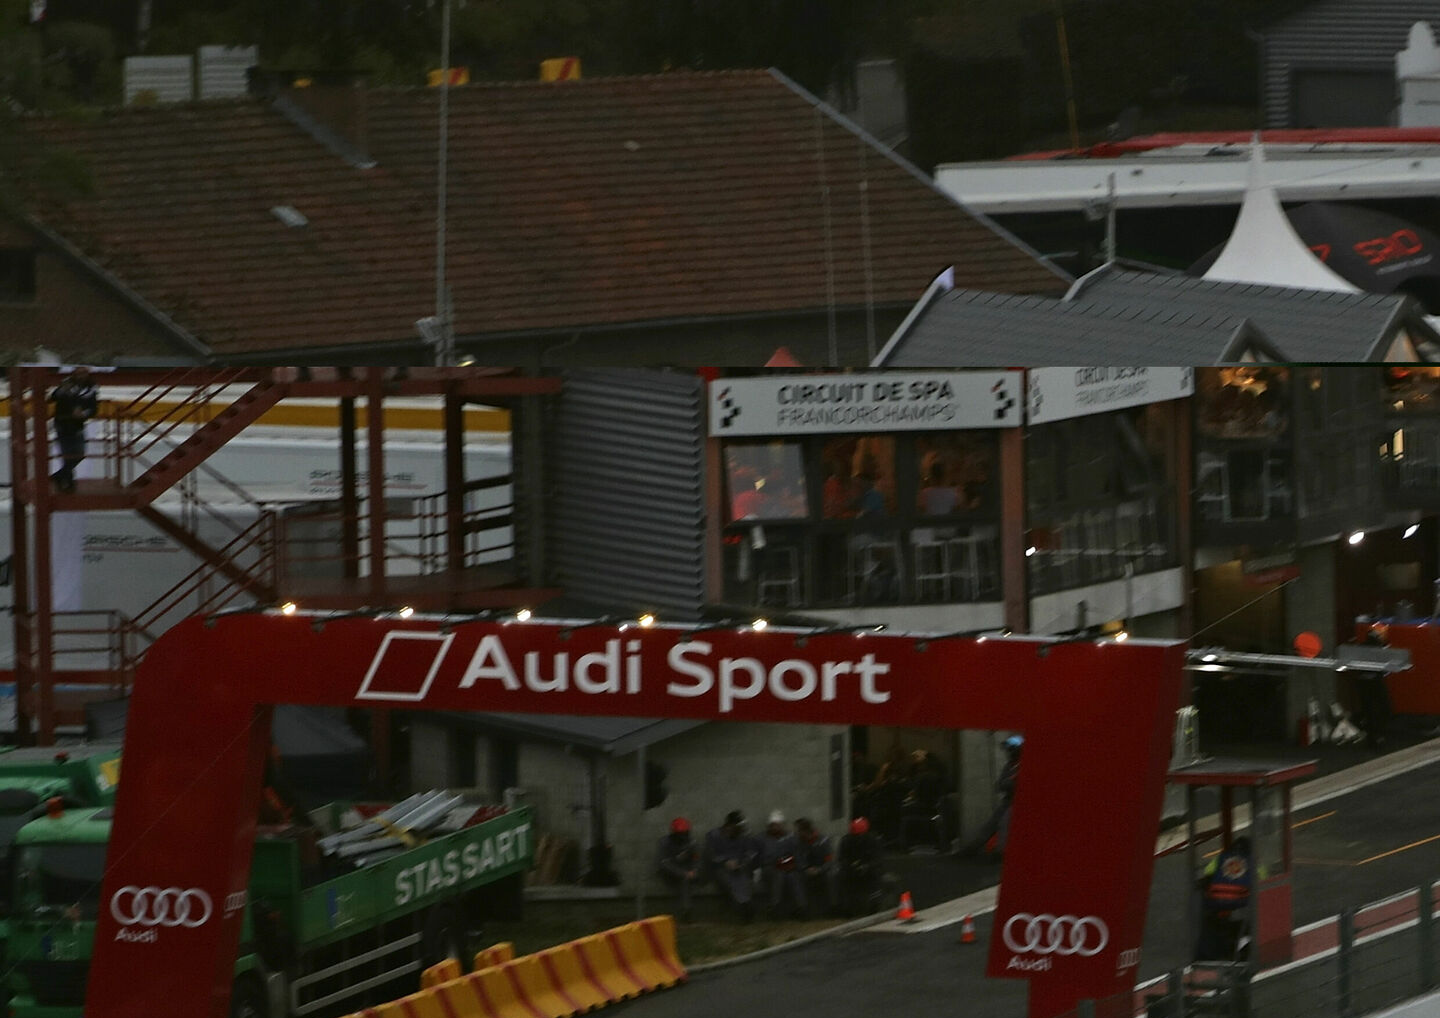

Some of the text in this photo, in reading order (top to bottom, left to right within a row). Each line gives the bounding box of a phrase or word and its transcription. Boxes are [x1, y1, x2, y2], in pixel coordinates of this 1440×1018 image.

[777, 380, 955, 405] CIRCUIT DE SPA
[777, 403, 956, 427] FRANCORCHAMPS
[457, 635, 892, 713] Audi Sport
[113, 927, 159, 943] Audi
[1006, 955, 1053, 971] Audi
